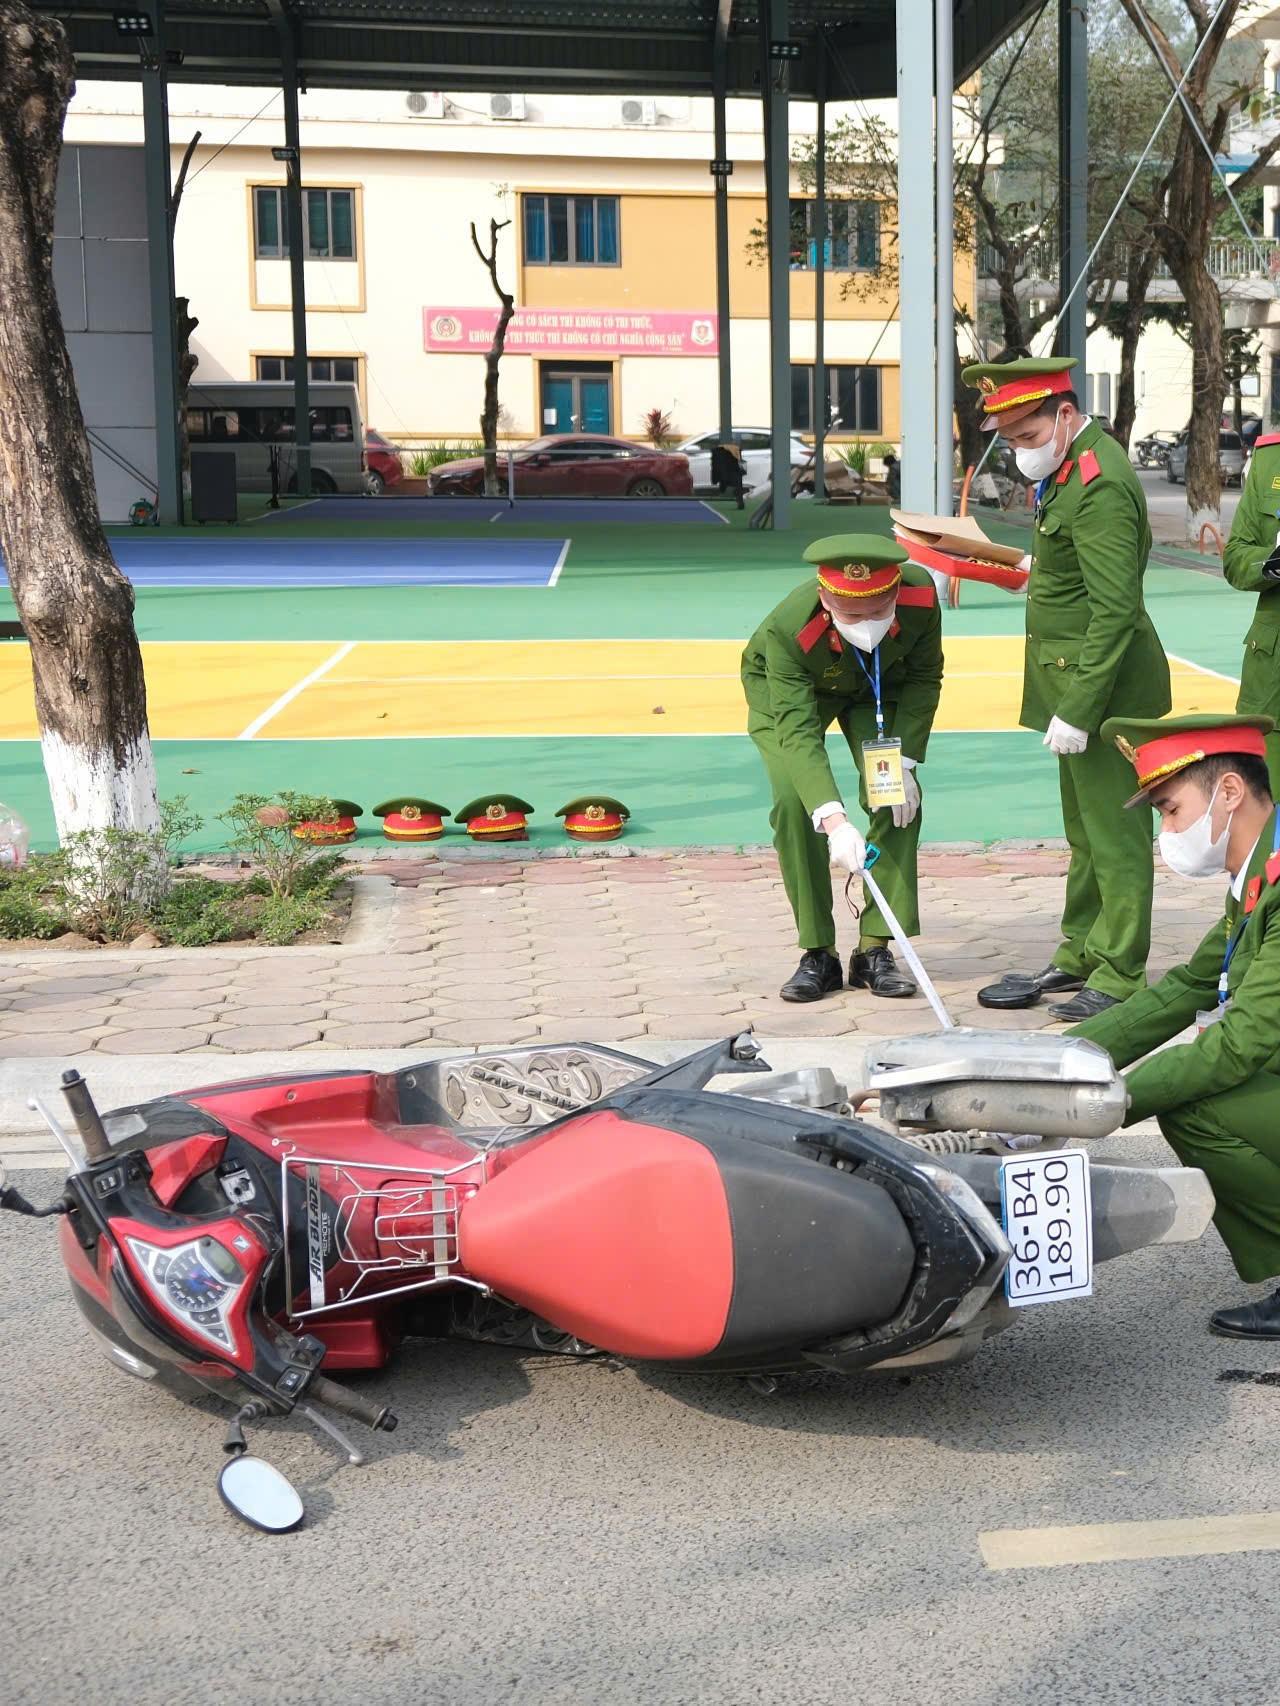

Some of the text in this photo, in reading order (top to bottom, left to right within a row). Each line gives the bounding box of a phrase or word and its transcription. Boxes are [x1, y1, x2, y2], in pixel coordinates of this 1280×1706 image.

[308, 1176, 323, 1283] AIR BLADE
[1011, 1167, 1042, 1289] 36-B4
[1043, 1160, 1073, 1287] 189.90
